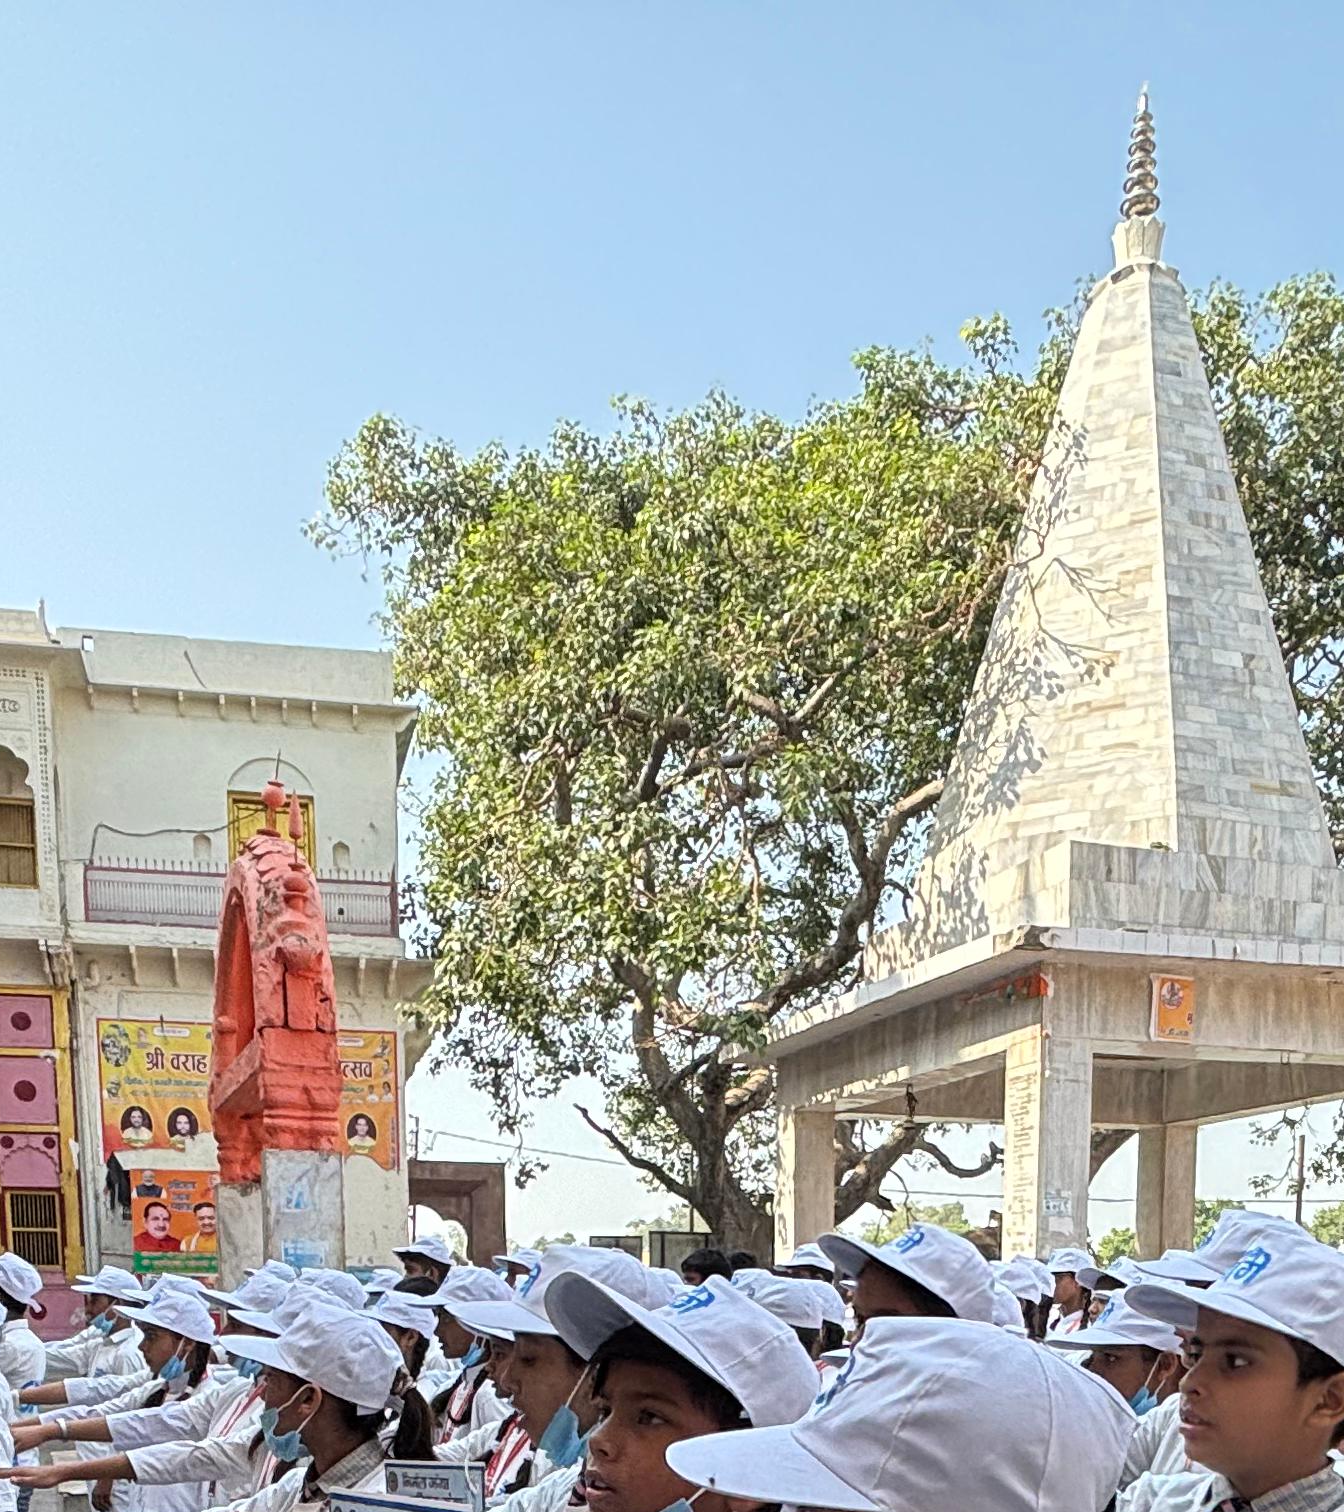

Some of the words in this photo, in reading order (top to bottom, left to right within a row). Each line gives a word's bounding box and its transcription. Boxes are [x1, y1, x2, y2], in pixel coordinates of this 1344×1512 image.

[145, 1047, 165, 1072] श्री
[170, 1053, 209, 1074] वराह
[339, 1061, 373, 1079] त्सव
